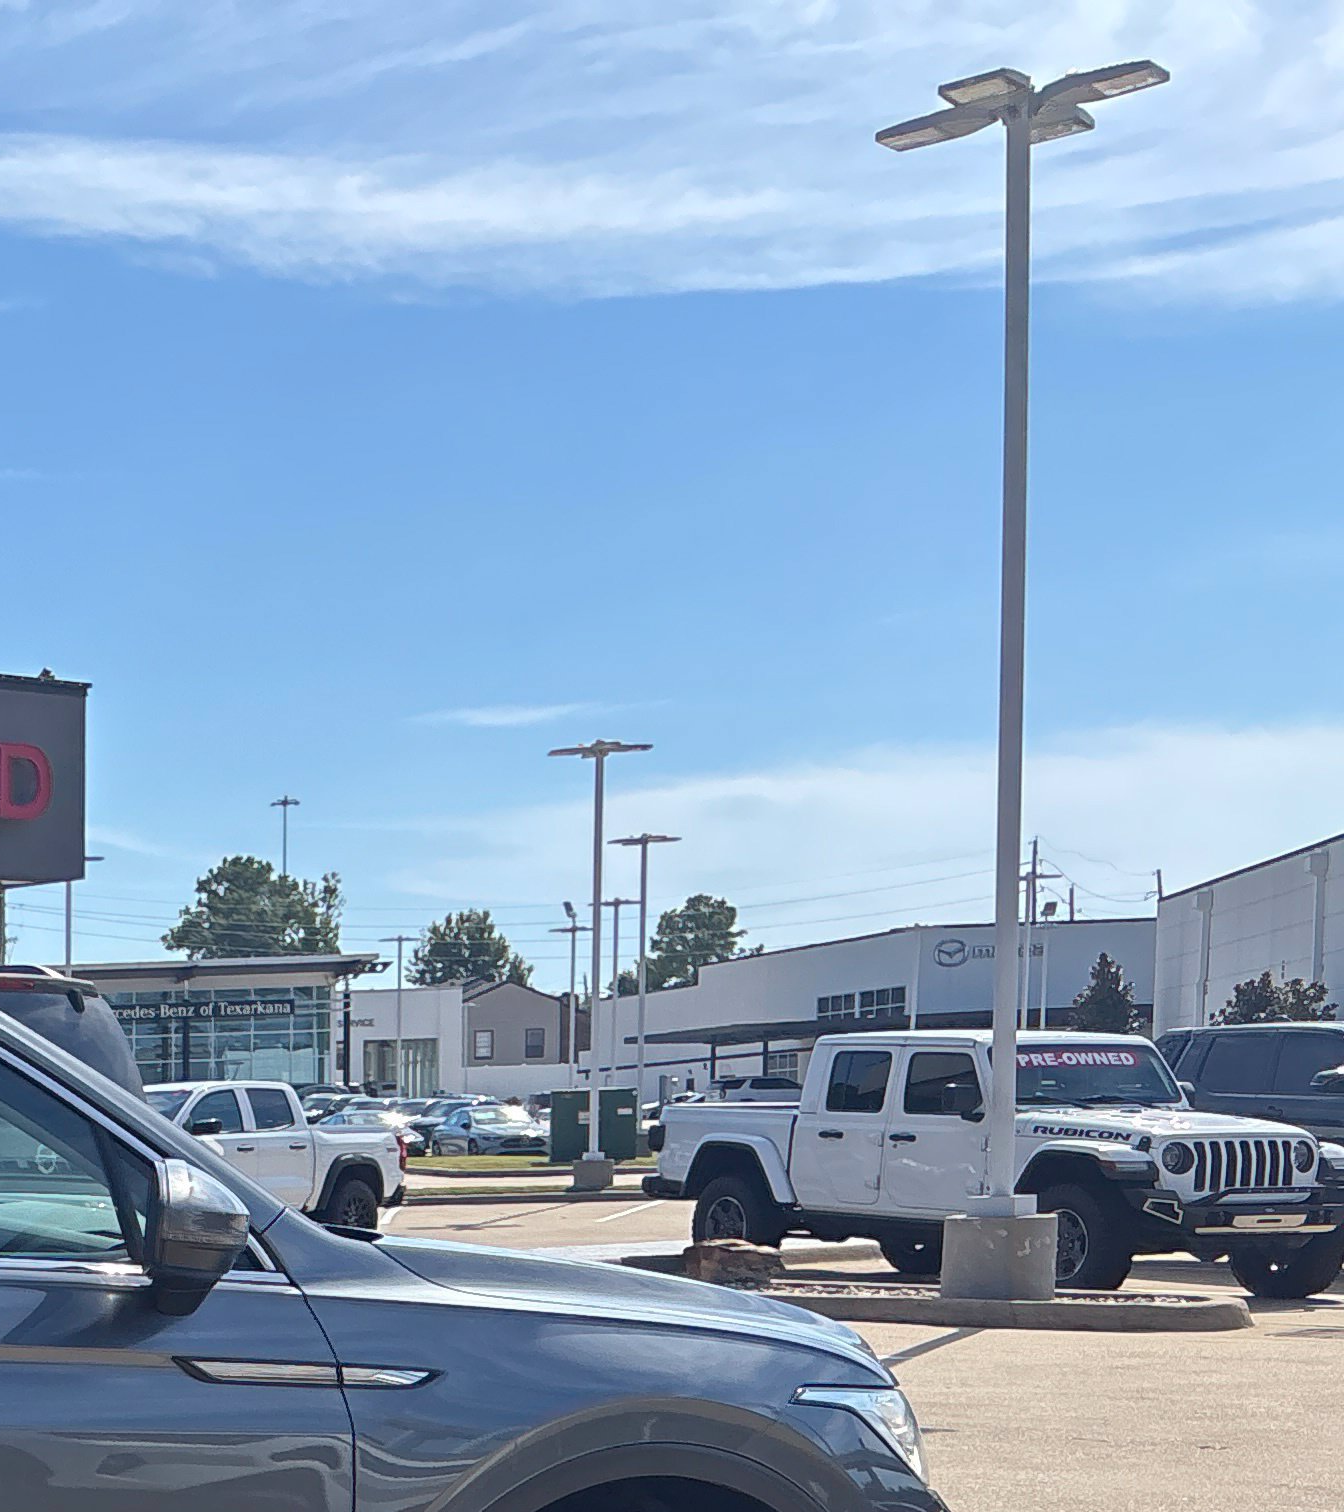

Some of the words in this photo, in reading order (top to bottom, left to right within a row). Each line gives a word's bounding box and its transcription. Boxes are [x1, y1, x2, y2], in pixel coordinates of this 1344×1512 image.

[199, 1002, 214, 1017] of
[218, 1001, 291, 1016] Texarkana
[337, 1018, 375, 1028] SRVICE
[1016, 1052, 1134, 1067] PRE-OWNED
[1032, 1125, 1132, 1141] RUBICON
